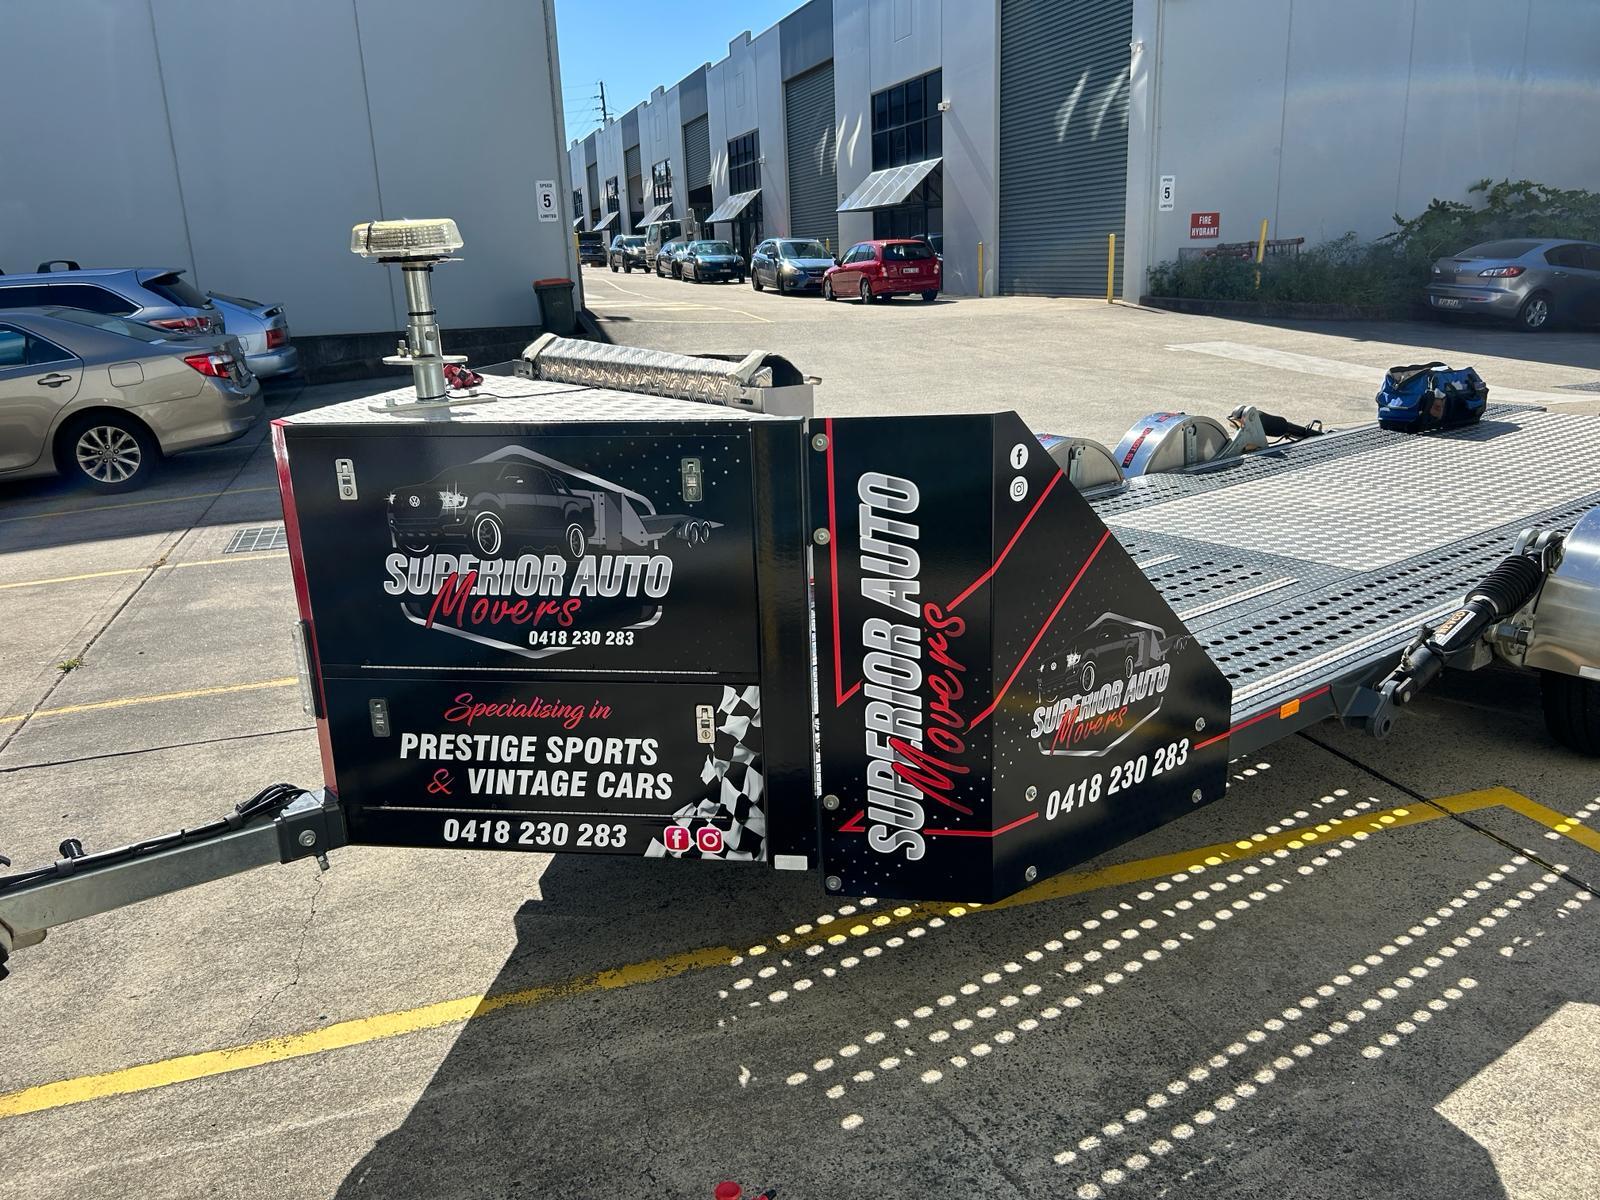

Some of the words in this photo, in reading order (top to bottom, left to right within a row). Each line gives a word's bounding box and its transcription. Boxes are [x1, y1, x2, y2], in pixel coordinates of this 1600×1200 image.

[543, 194, 551, 208] 5
[1164, 187, 1170, 199] 5
[1191, 226, 1218, 237] HYDRANT
[1198, 215, 1212, 225] FIRE
[857, 471, 921, 618] AUTO
[383, 553, 567, 597] SUPERIOR
[569, 555, 673, 598] AUTO
[424, 571, 582, 629] Movers
[528, 631, 568, 645] 0418
[572, 631, 601, 645] 230
[605, 631, 635, 646] 283
[444, 692, 588, 730] Specialising
[588, 699, 613, 720] in
[888, 602, 974, 815] Movers
[1030, 679, 1124, 739] SUPERIOR
[1122, 663, 1171, 706] AUTO
[400, 732, 537, 763] PRESTIGE
[545, 735, 659, 766] SPORTS
[862, 617, 926, 861] SUPERIOR
[1050, 705, 1128, 756] Movers
[427, 768, 455, 795] &
[467, 768, 588, 797] VINTAGE
[596, 771, 674, 800] CARS
[1045, 773, 1103, 821] 0418
[1107, 755, 1148, 796] 230
[1151, 738, 1190, 777] 283
[443, 818, 511, 843] 0418
[518, 821, 569, 846] 230
[576, 823, 628, 848] 283
